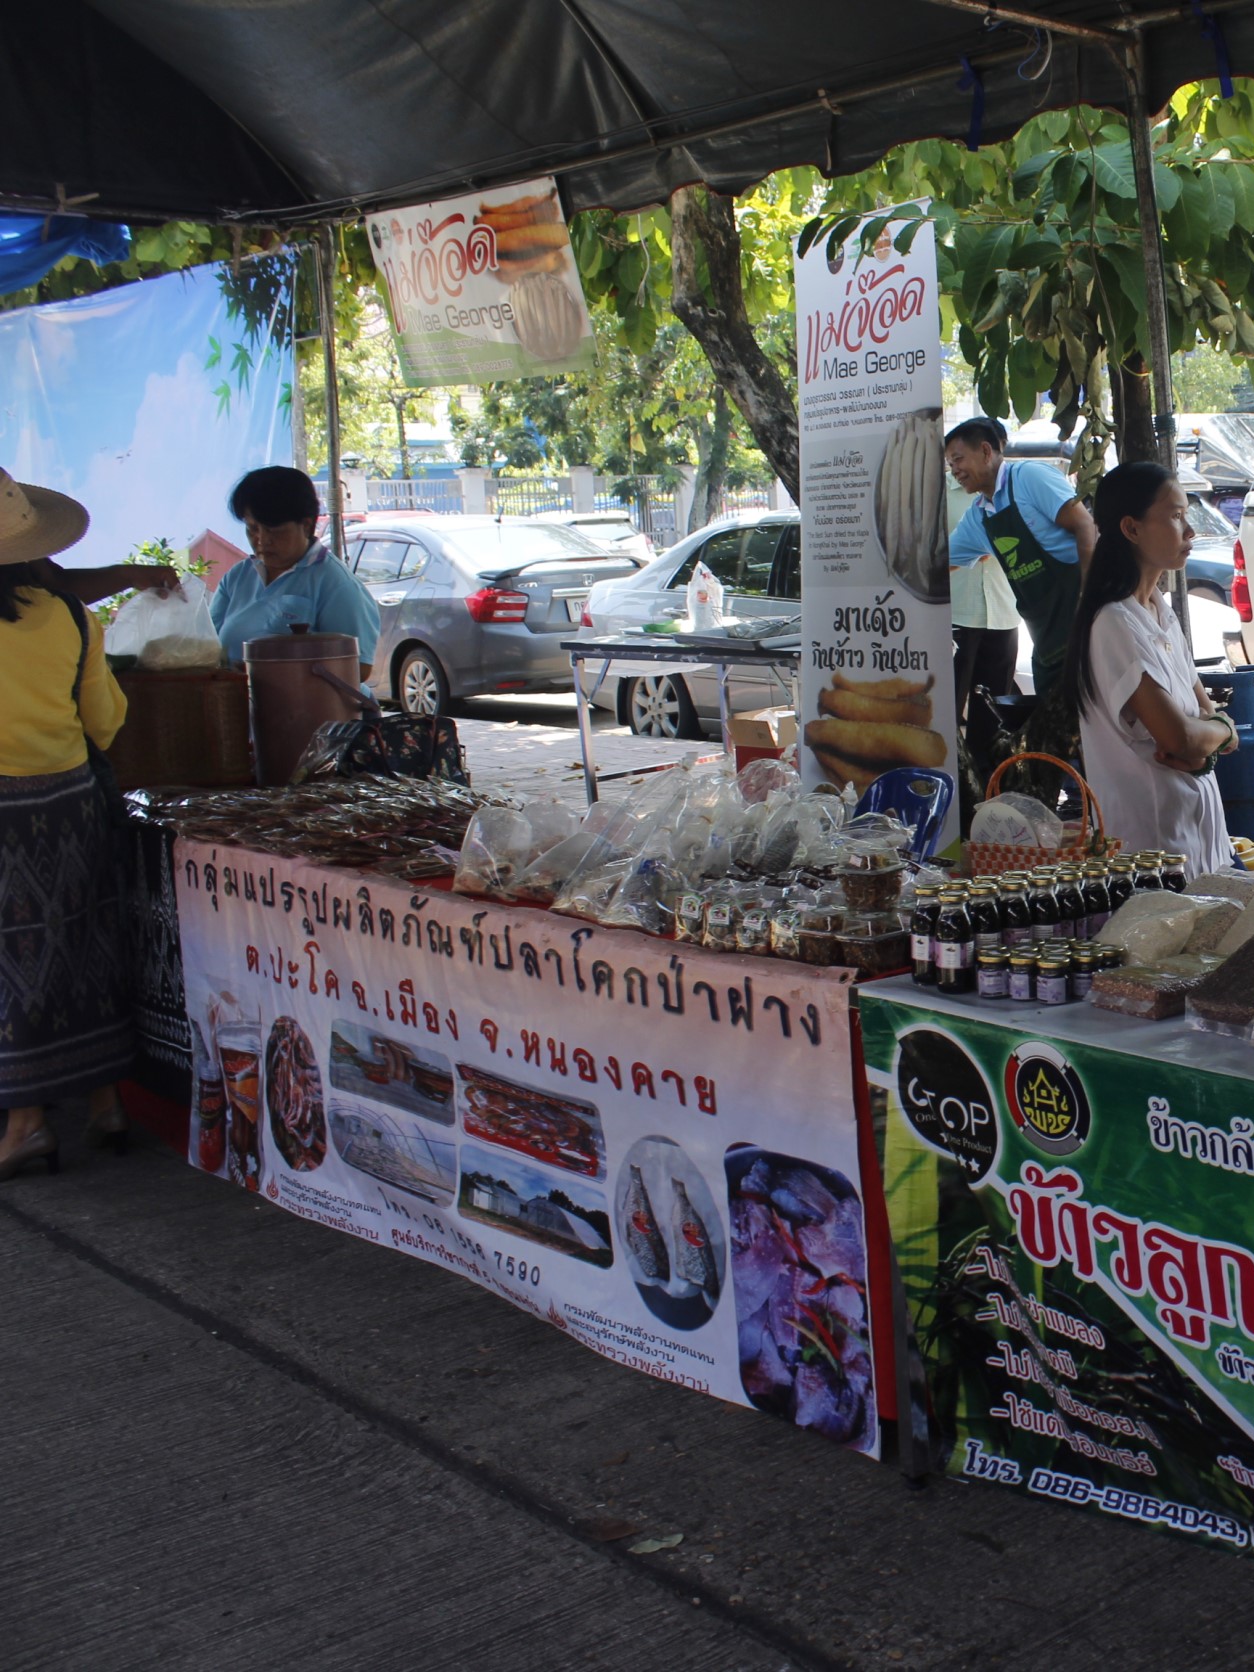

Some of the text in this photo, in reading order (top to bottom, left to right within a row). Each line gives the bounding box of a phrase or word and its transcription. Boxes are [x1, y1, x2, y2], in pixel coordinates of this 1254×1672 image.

[409, 302, 514, 335] Mae George
[804, 263, 926, 384] แม่จ๊อด
[823, 349, 926, 381] Mae George
[833, 590, 906, 637] มาเด้อ
[811, 636, 929, 673] กินข้าว กินปลา
[184, 849, 821, 1046] กลุ่มแปรรูปผลิตภัณฑ์ปลาโคกป่าฝาง
[246, 940, 719, 1116] ต.ปะโค อ.เมือง จ.หนองคาย
[962, 1136, 993, 1154] Product
[494, 1250, 541, 1287] 7590
[564, 1302, 716, 1366] กรมพัฒนาพลังงานทดแทน
[566, 1315, 676, 1364] และอนุรักษ์พลังงาน
[571, 1327, 710, 1394] กระทรวงพลังงาน
[963, 1442, 1022, 1487] โทร.
[1030, 1467, 1247, 1550] 086-9864043,
